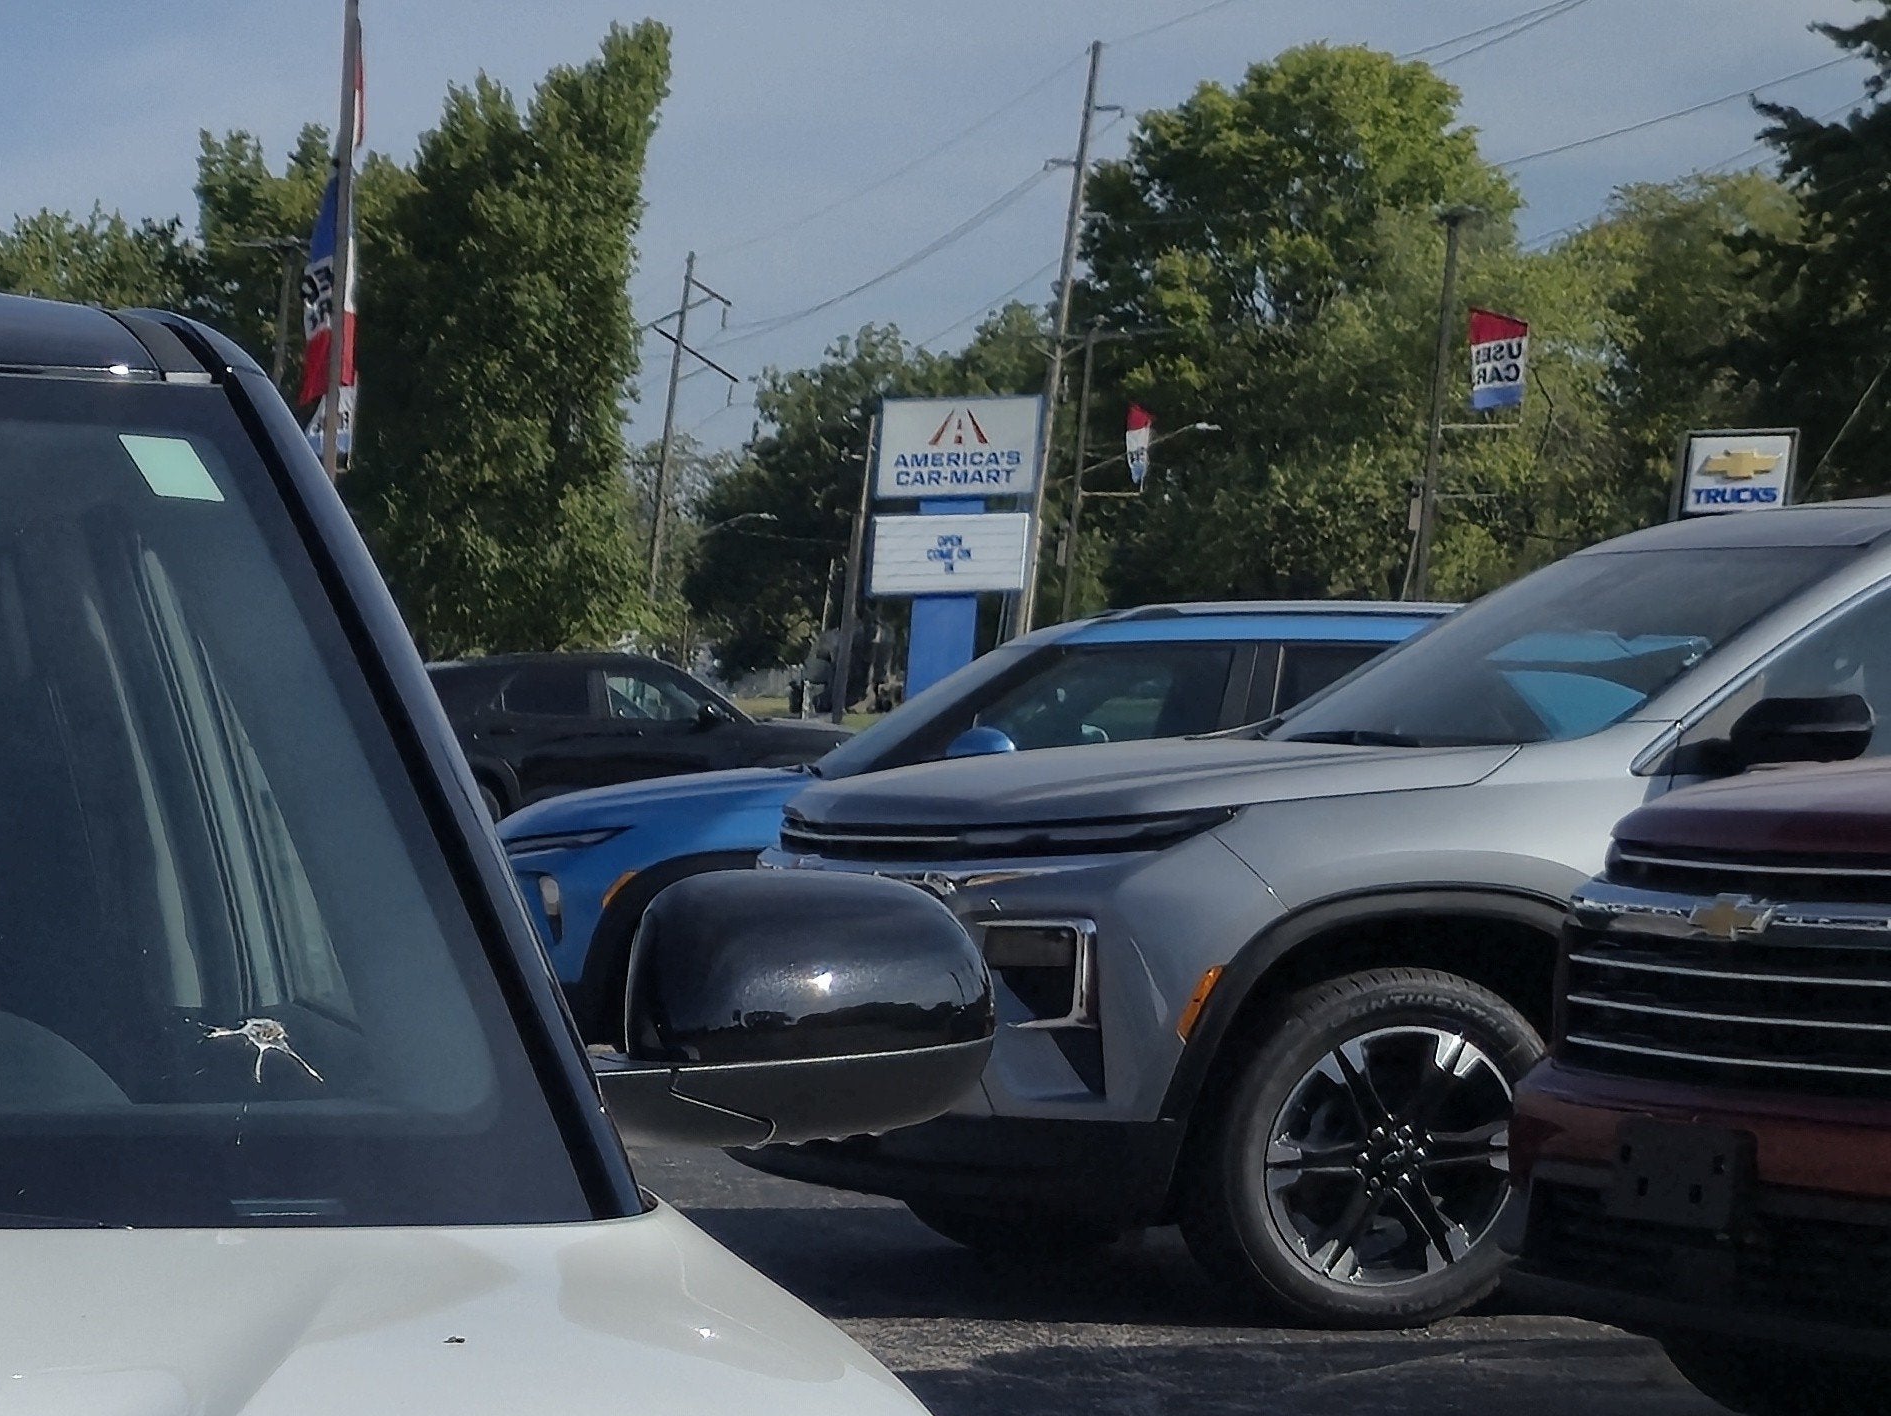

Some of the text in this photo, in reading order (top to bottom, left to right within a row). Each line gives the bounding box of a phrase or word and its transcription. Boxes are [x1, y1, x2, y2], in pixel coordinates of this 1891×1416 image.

[894, 451, 1021, 467] AMERICA'S
[896, 469, 1016, 485] CAR-MART
[1692, 487, 1777, 504] TRUCKS
